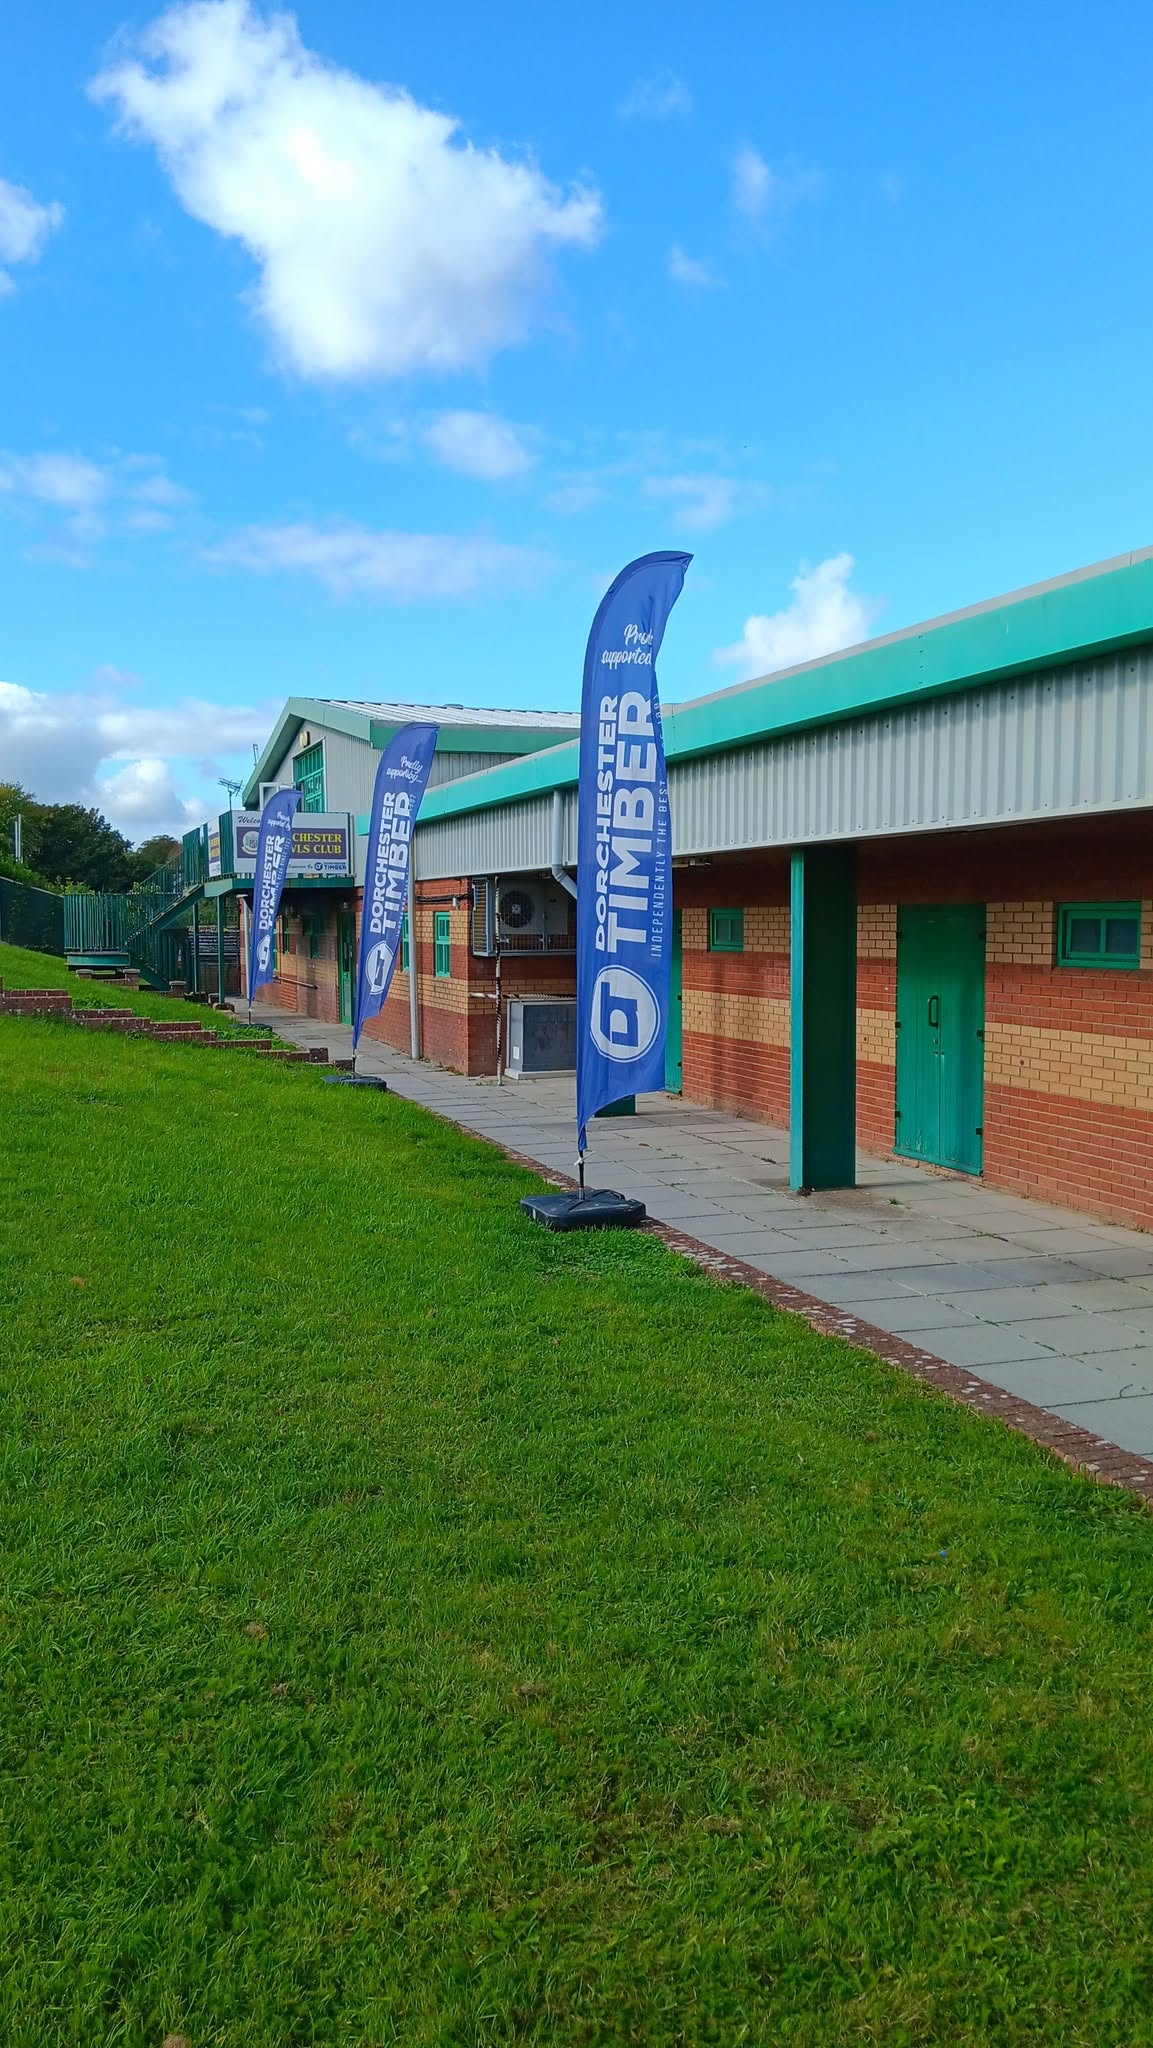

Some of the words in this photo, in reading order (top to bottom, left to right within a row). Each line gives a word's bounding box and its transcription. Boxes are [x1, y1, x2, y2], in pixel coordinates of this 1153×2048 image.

[292, 833, 342, 843] CHESTER
[313, 844, 342, 854] CLUB
[370, 792, 395, 933] DORCHESTER
[595, 695, 618, 951] DORCHESTER
[607, 691, 656, 953] TIMBER
[657, 824, 666, 843] THE
[259, 835, 275, 930] DORCHESTER
[651, 851, 665, 957] INDEPENDENTLY
